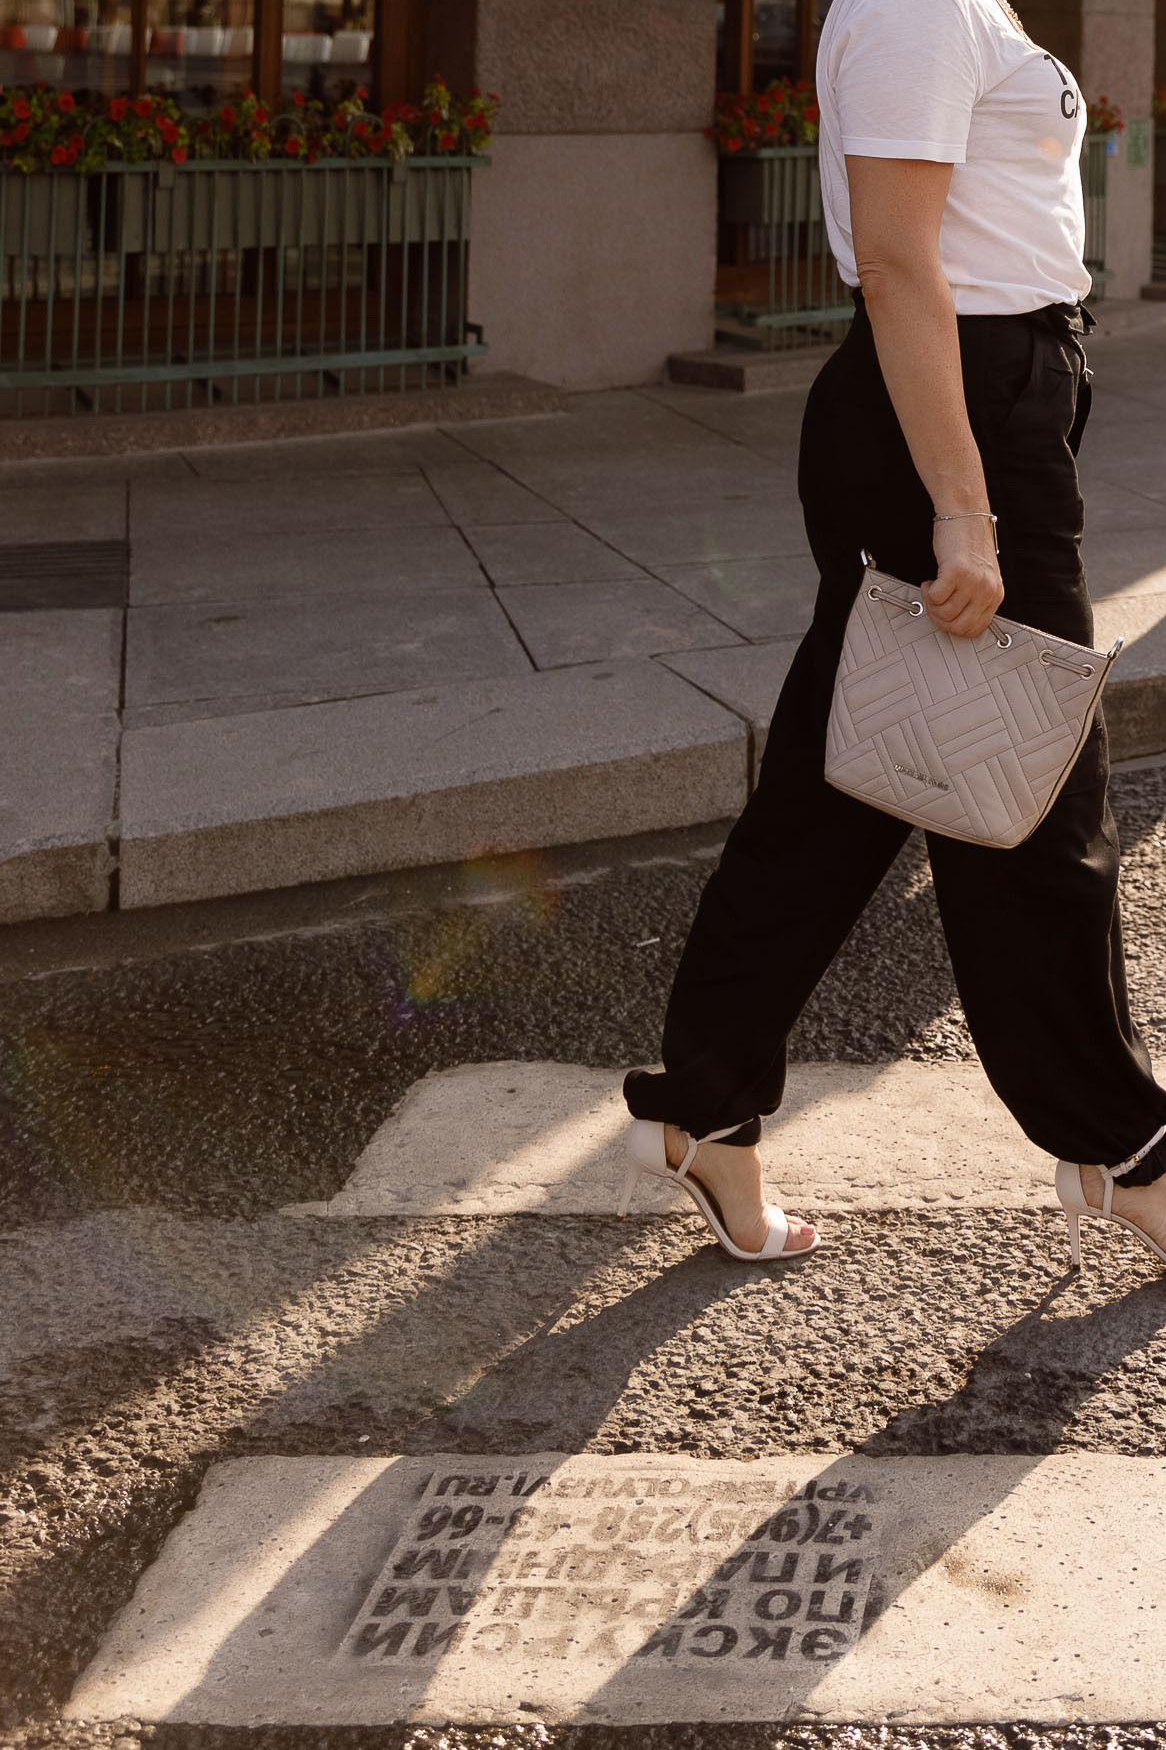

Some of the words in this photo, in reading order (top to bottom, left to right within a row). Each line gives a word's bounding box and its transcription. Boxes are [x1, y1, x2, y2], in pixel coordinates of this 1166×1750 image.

[813, 1553, 865, 1586] И
[754, 1588, 857, 1624] ПО
[349, 1621, 853, 1661] ЭКСКУРСИИ
